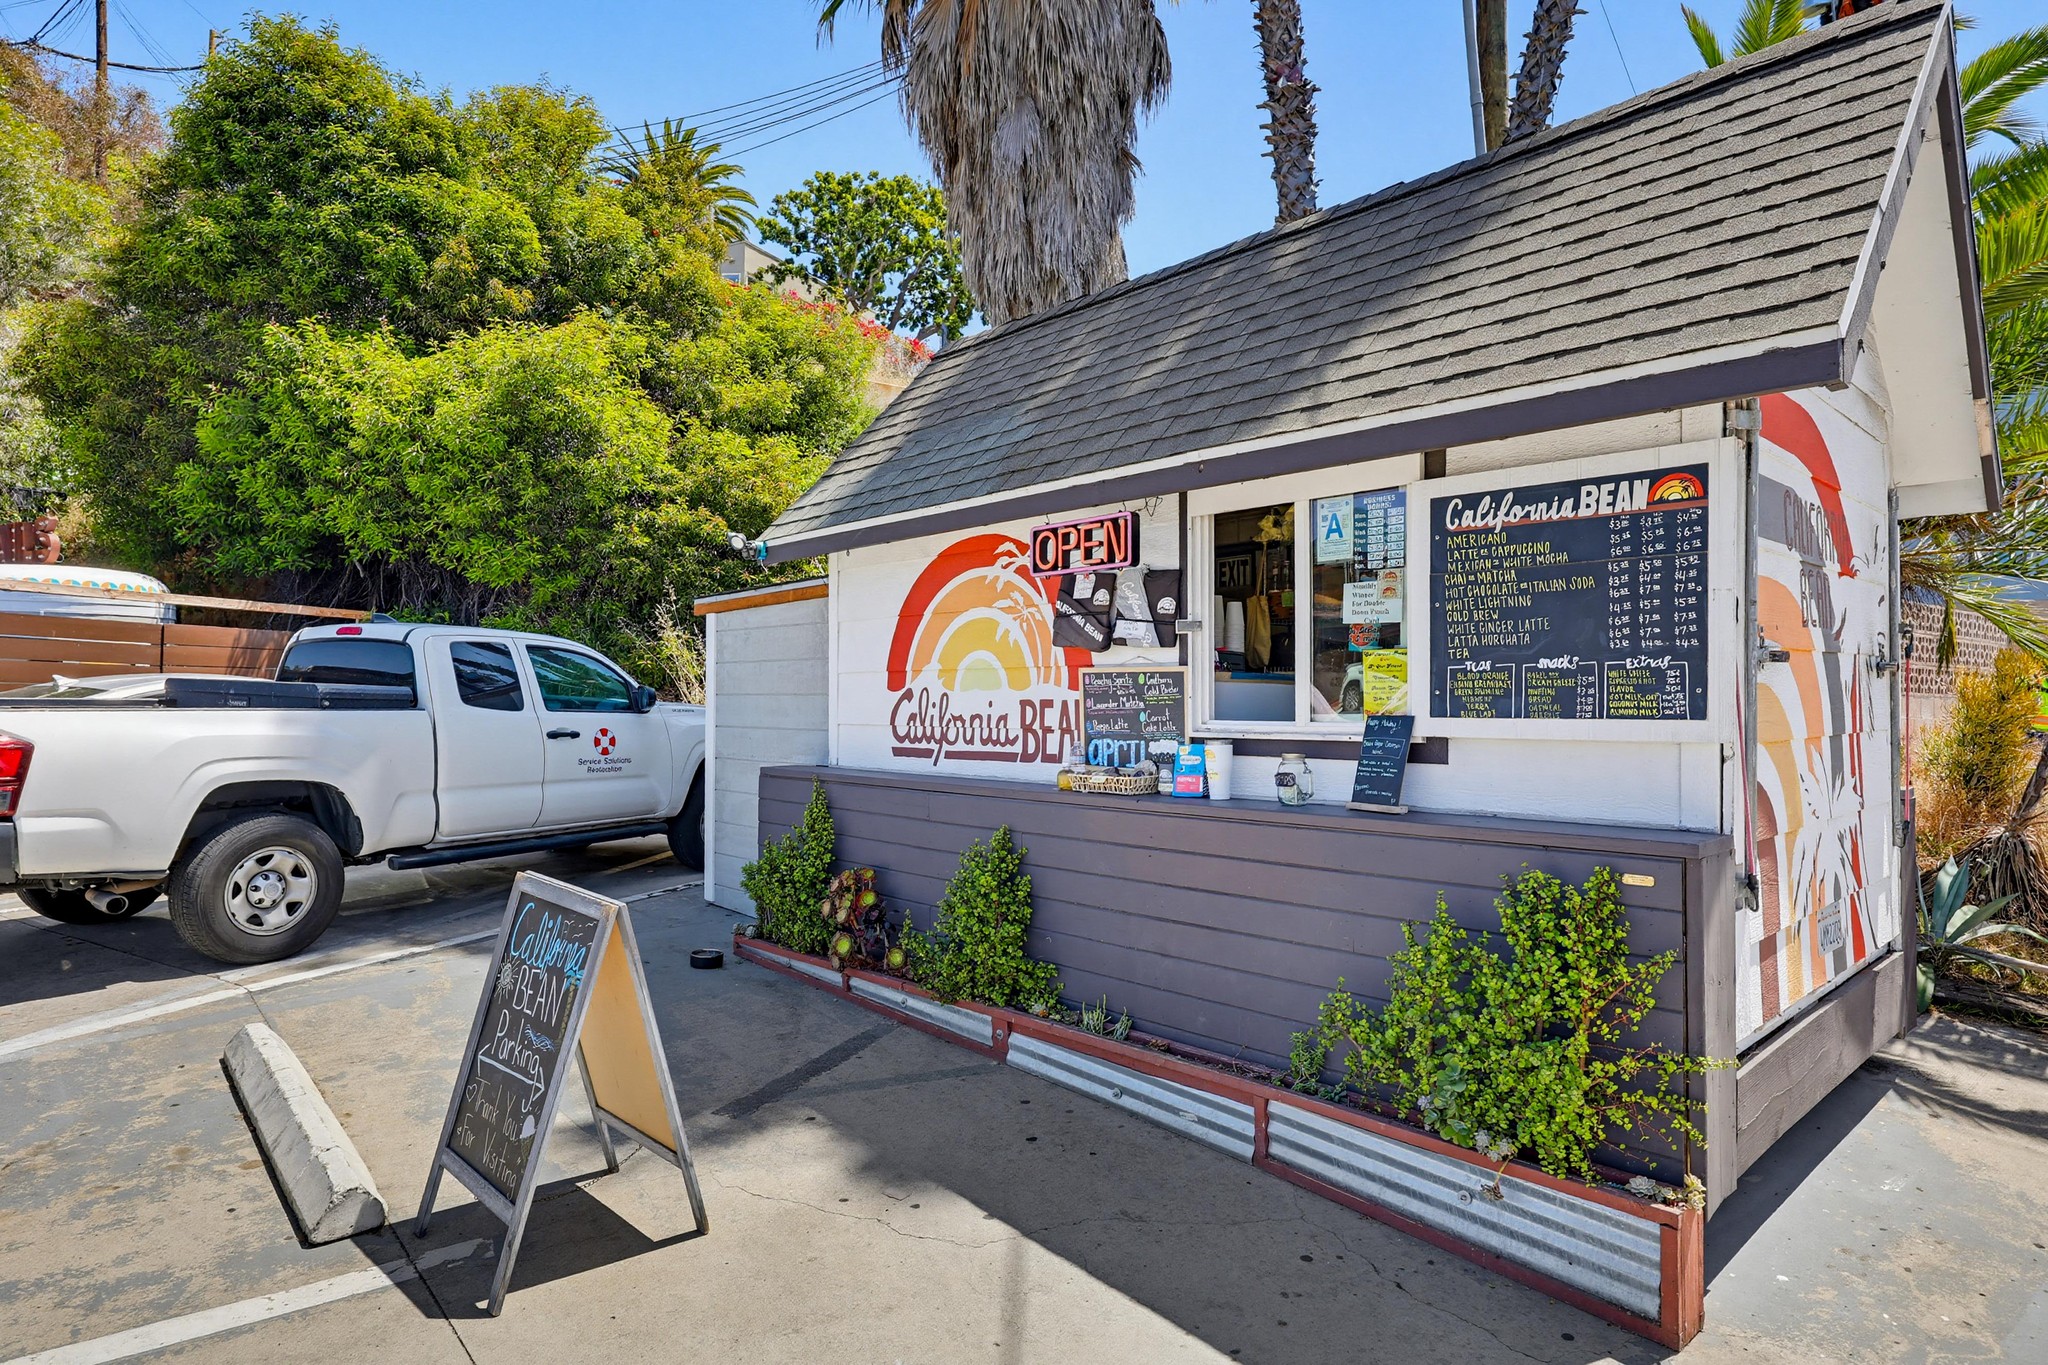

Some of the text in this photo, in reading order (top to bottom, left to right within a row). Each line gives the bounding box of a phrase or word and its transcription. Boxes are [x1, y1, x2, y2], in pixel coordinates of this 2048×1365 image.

[1446, 478, 1650, 533] California BEAN
[1325, 512, 1344, 540] A
[1035, 518, 1126, 570] OPEN
[1447, 532, 1507, 549] AMERICANO
[1447, 549, 1479, 562] LATTE
[1492, 541, 1550, 557] CAPPUCCINO
[1219, 559, 1249, 587] EXIT
[1448, 558, 1491, 573] MEXICAN
[1503, 556, 1533, 569] WHITE
[1536, 552, 1569, 566] MOCHA
[1445, 573, 1467, 586] CHAI
[1477, 570, 1517, 584] MATCHA
[1445, 587, 1465, 599] HOT
[1467, 582, 1520, 597] CHOCOLATE
[1529, 578, 1567, 593] ITALIAN
[1569, 576, 1596, 590] SODA
[1445, 595, 1532, 611] WHITE LIGHTNING
[1800, 568, 1835, 630] BEAN
[1447, 610, 1499, 622] COLD BREW
[1447, 617, 1551, 634] WHITE GINGER LATTE
[1084, 622, 1104, 642] BEAN
[1448, 633, 1531, 647] LATTA HORCHATA
[1448, 648, 1470, 659] TEA
[1146, 707, 1170, 722] Carrot
[890, 687, 1080, 767] California BEA
[510, 902, 587, 980] California
[512, 965, 567, 1027] BEAN
[491, 1009, 540, 1113] Parking
[474, 1076, 519, 1142] Thank You
[460, 1113, 518, 1200] For Visiting
